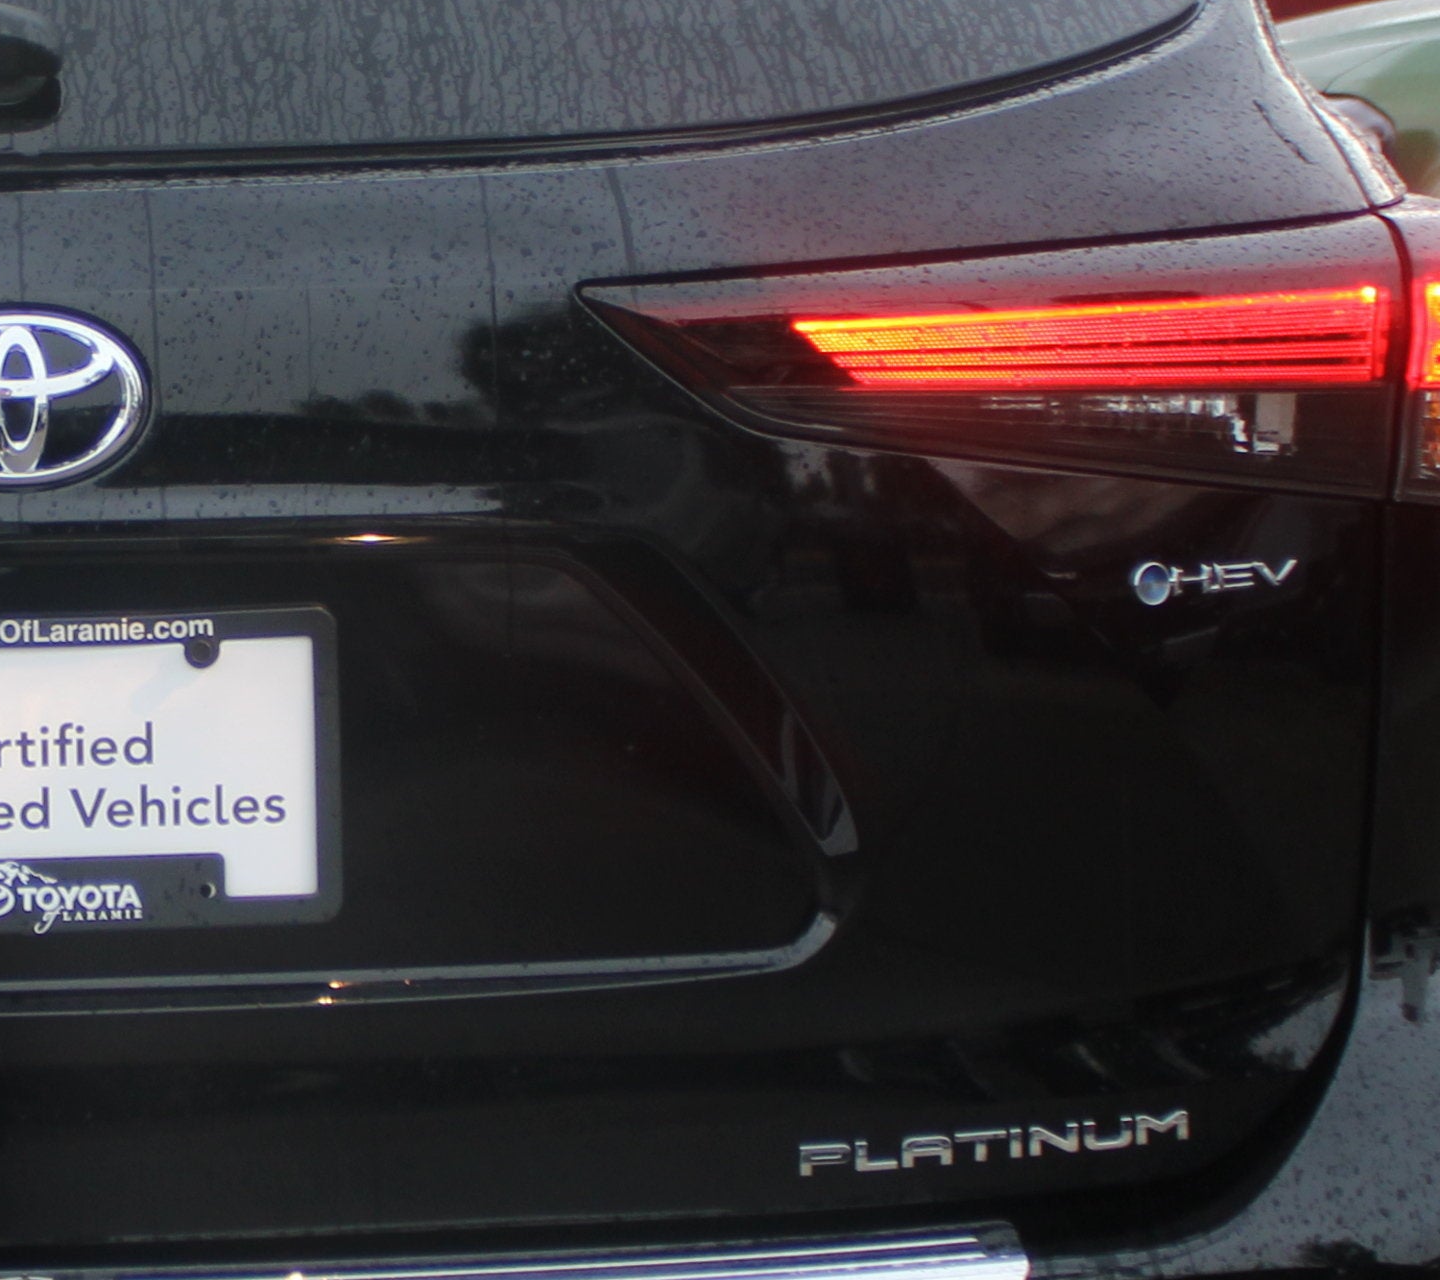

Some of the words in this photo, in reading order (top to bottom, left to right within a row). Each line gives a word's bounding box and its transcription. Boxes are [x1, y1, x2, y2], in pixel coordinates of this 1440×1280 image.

[68, 783, 287, 829] Vehicles
[16, 884, 143, 912] TOYOTA
[62, 909, 144, 922] LARAMIE
[799, 1109, 1189, 1177] PLATINUM
